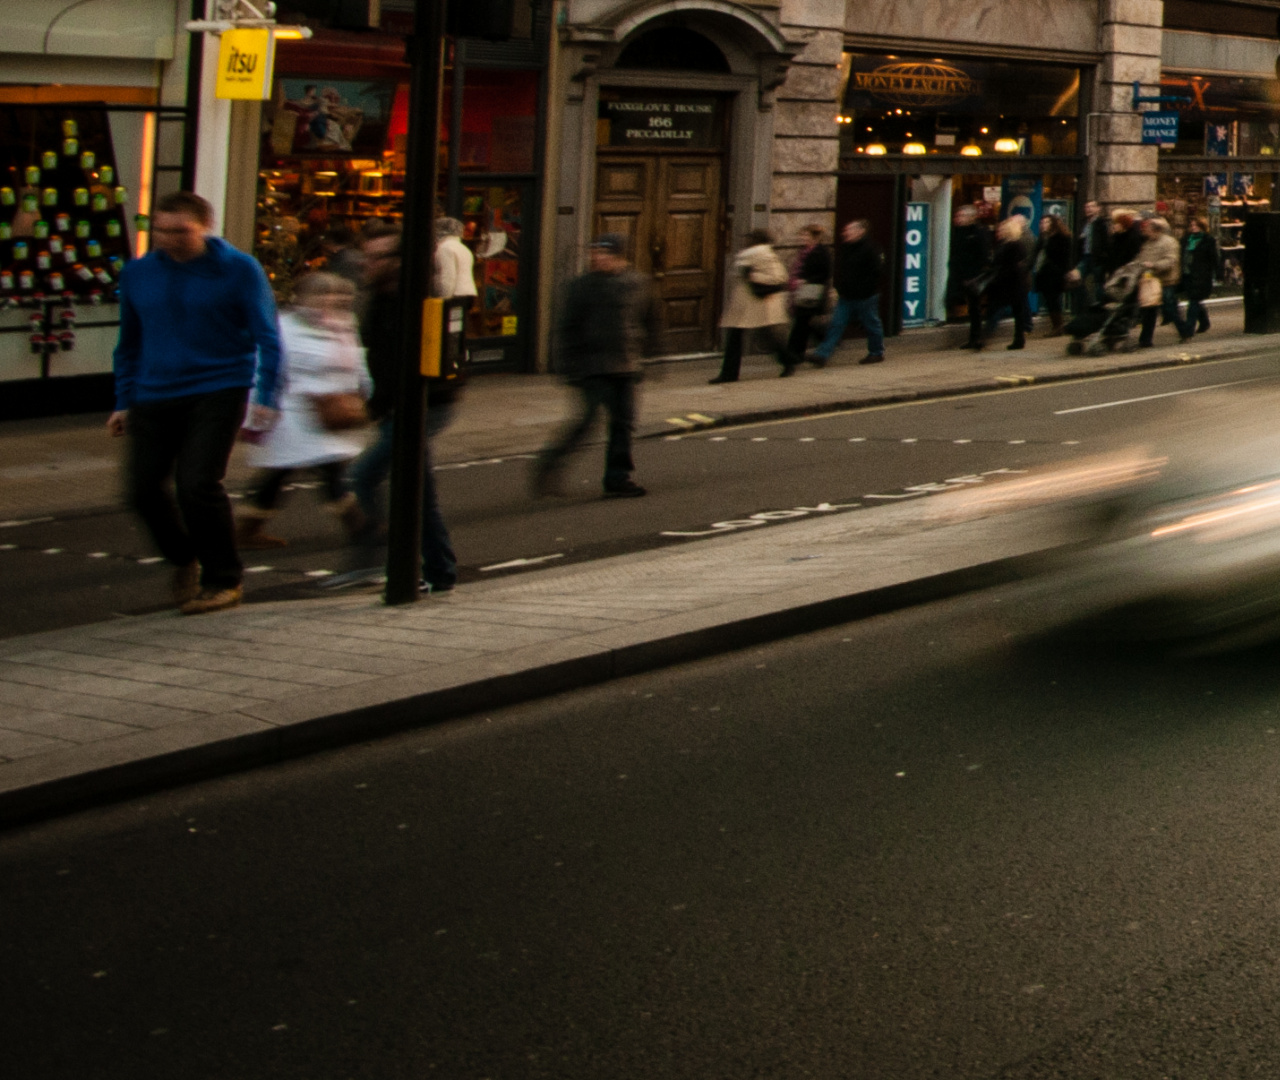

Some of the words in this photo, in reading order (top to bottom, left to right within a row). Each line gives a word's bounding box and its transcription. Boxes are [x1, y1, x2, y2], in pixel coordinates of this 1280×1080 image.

[227, 45, 258, 74] itsu
[856, 73, 905, 90] MONEY
[910, 77, 980, 94] EXCHANG
[608, 102, 671, 113] FOXGLOVE
[675, 103, 712, 113] HOUSE
[649, 117, 673, 128] 166
[1144, 117, 1177, 126] MONEY
[626, 129, 694, 139] PICCADILLY
[1143, 128, 1177, 138] CHANGE
[904, 205, 924, 317] MONEY
[661, 502, 861, 536] LOOK
